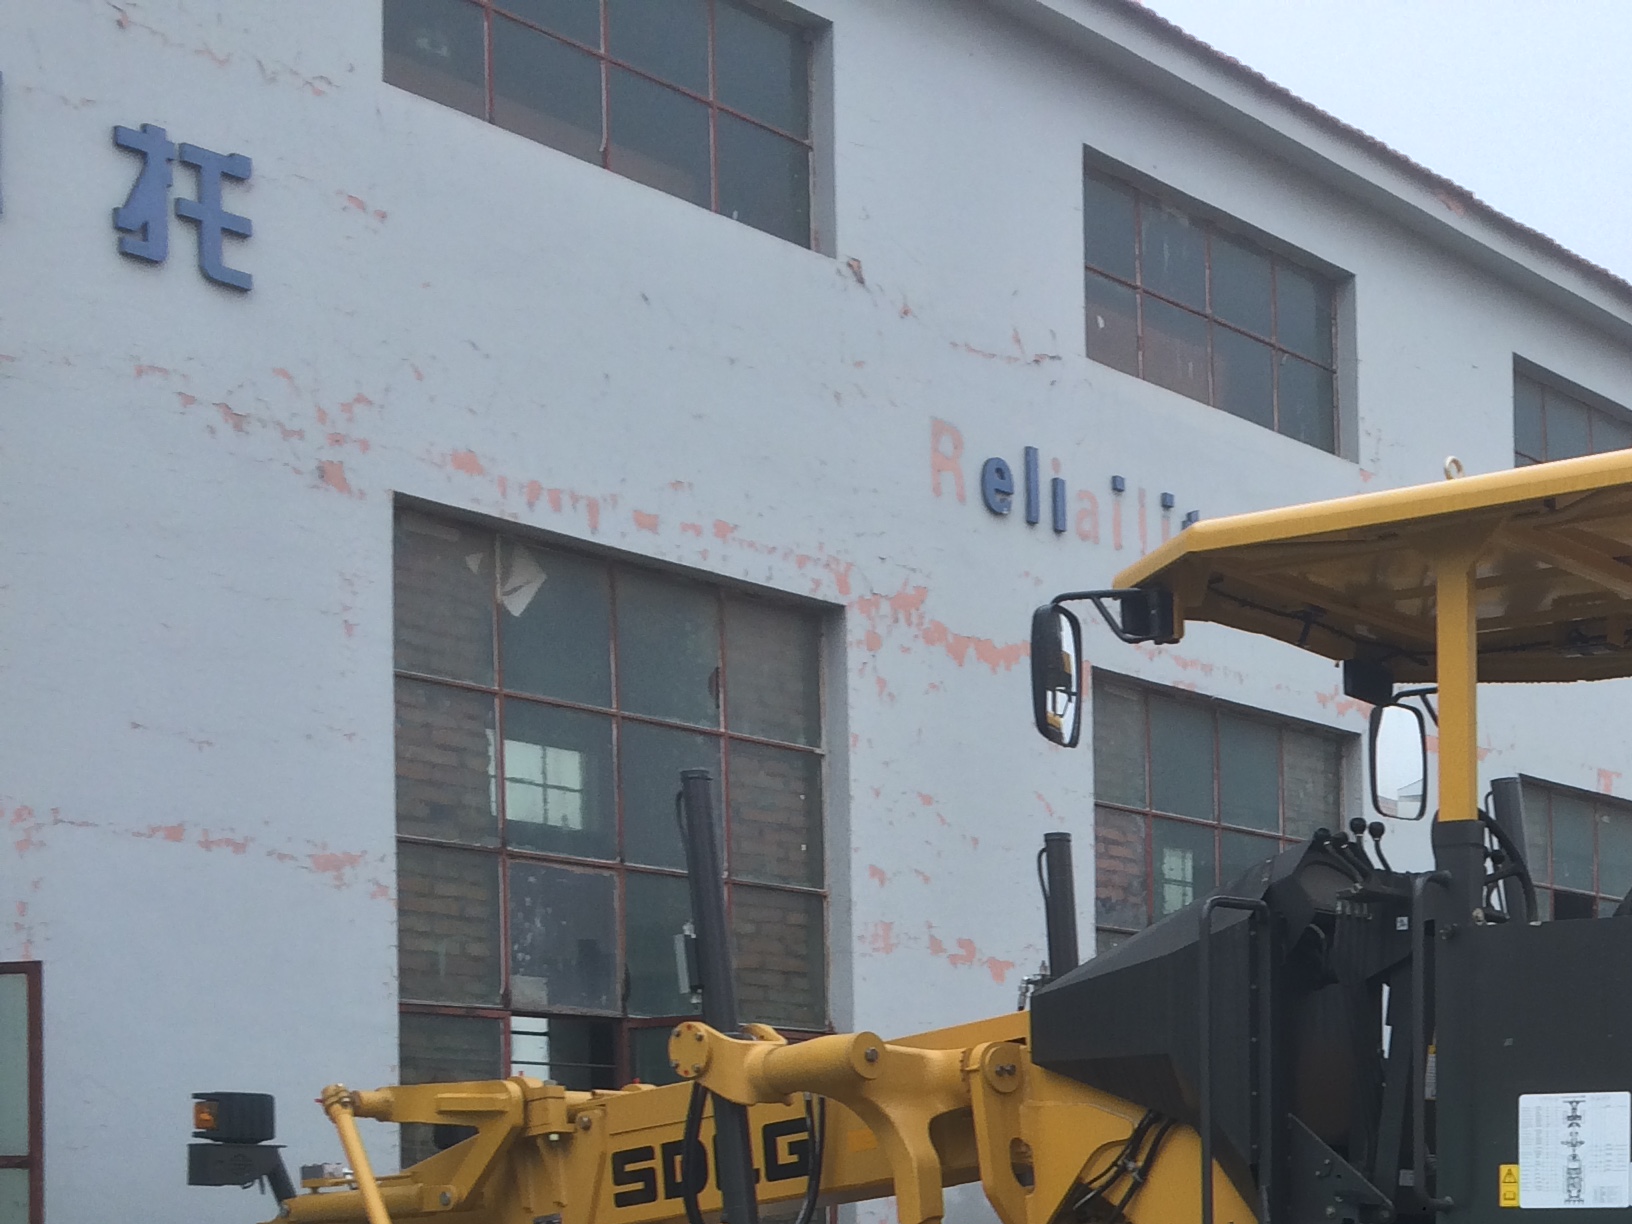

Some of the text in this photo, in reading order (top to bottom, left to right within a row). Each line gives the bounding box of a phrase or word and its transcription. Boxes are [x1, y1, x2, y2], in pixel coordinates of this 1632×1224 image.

[113, 122, 253, 291] 托
[930, 416, 1200, 554] Reliaili
[611, 1116, 811, 1208] SDG
